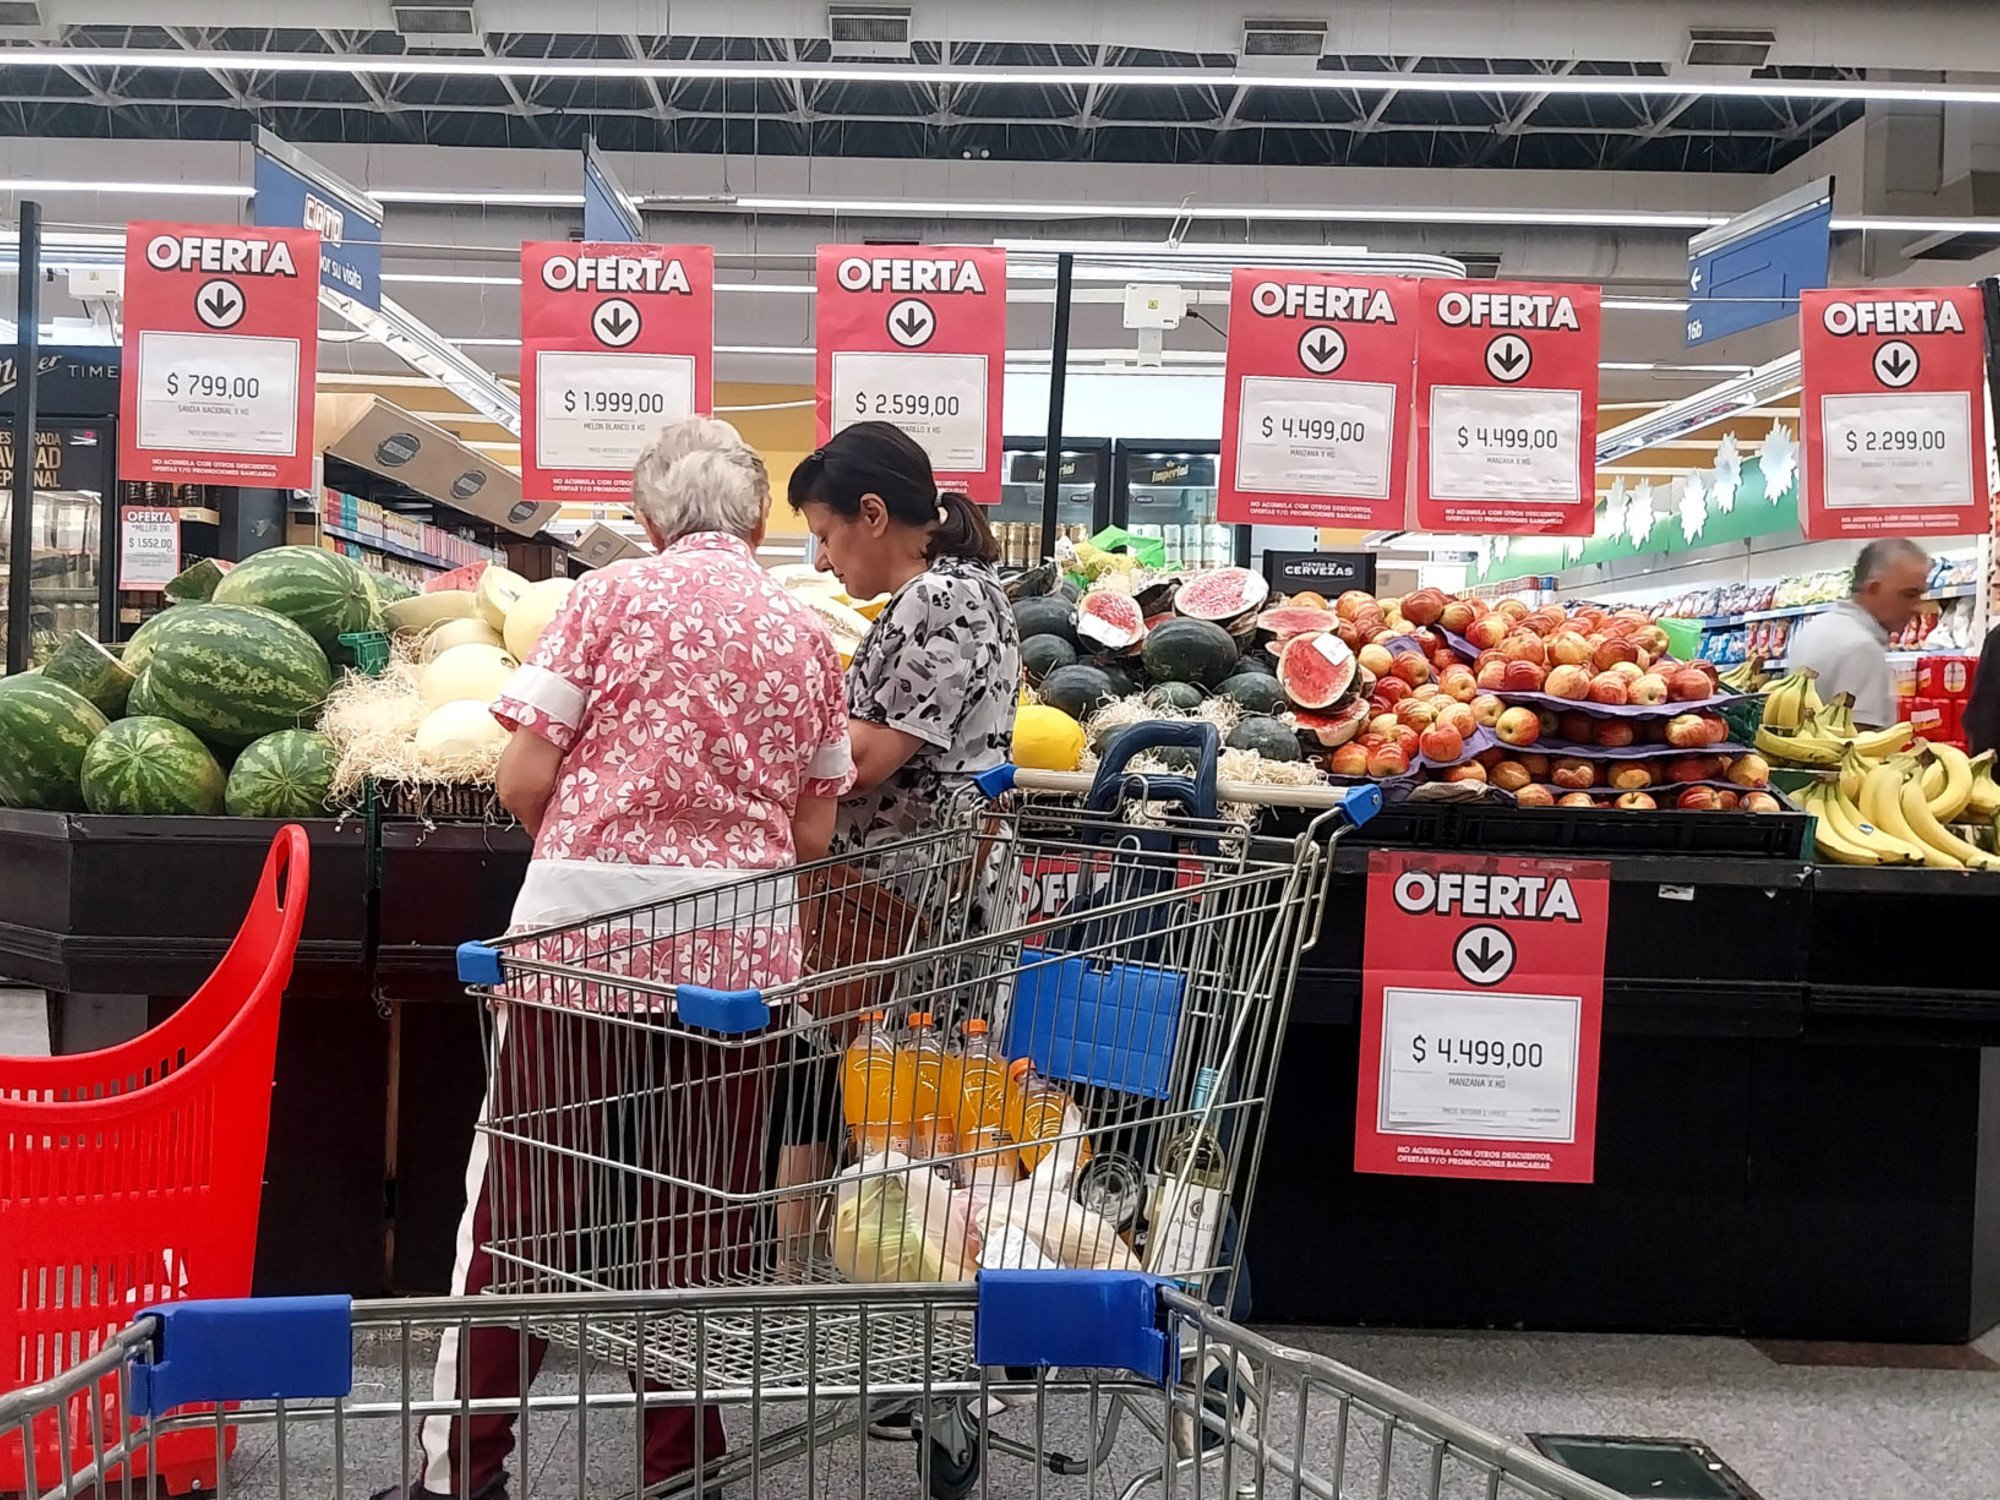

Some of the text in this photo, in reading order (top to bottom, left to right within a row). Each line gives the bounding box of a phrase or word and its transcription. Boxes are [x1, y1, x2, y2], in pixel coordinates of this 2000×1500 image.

[147, 235, 297, 277] OFERTA
[342, 263, 362, 290] visita
[541, 256, 692, 295] OFERTA
[837, 257, 986, 295] OFERTA
[1250, 282, 1397, 324] OFERTA
[1437, 292, 1580, 330] OFERTA
[1687, 319, 1702, 340] 16b
[1824, 300, 1965, 337] OFERTA
[67, 365, 119, 378] TIME
[167, 372, 259, 399] $ 799,00
[178, 405, 200, 413] SANDIA
[202, 406, 232, 415] NACIONAL
[565, 389, 664, 415] $ 1.999,00
[856, 391, 959, 417] $ 2.599,00
[584, 422, 603, 430] MELON
[605, 423, 629, 431] BLANCO
[1262, 415, 1365, 443] $ 4.499,00
[1458, 425, 1558, 450] $ 4.499,00
[1846, 430, 1945, 452] $ 2.299,00
[1151, 464, 1189, 482] Imperial
[127, 511, 173, 523] OFERTA
[128, 537, 135, 549] $
[1284, 565, 1354, 577] CERVEZAS
[1393, 870, 1582, 923] OFERTA
[1412, 1034, 1543, 1069] $ 4.499,00
[1449, 1077, 1506, 1089] MANZANA X KG
[1397, 1145, 1410, 1154] NO
[1412, 1146, 1451, 1156] ACUMULA
[1453, 1148, 1472, 1157] CON
[1474, 1149, 1500, 1159] OTROS
[1397, 1155, 1551, 1169] OFERTAS Y/O PROMOCIONES BANCARIAS
